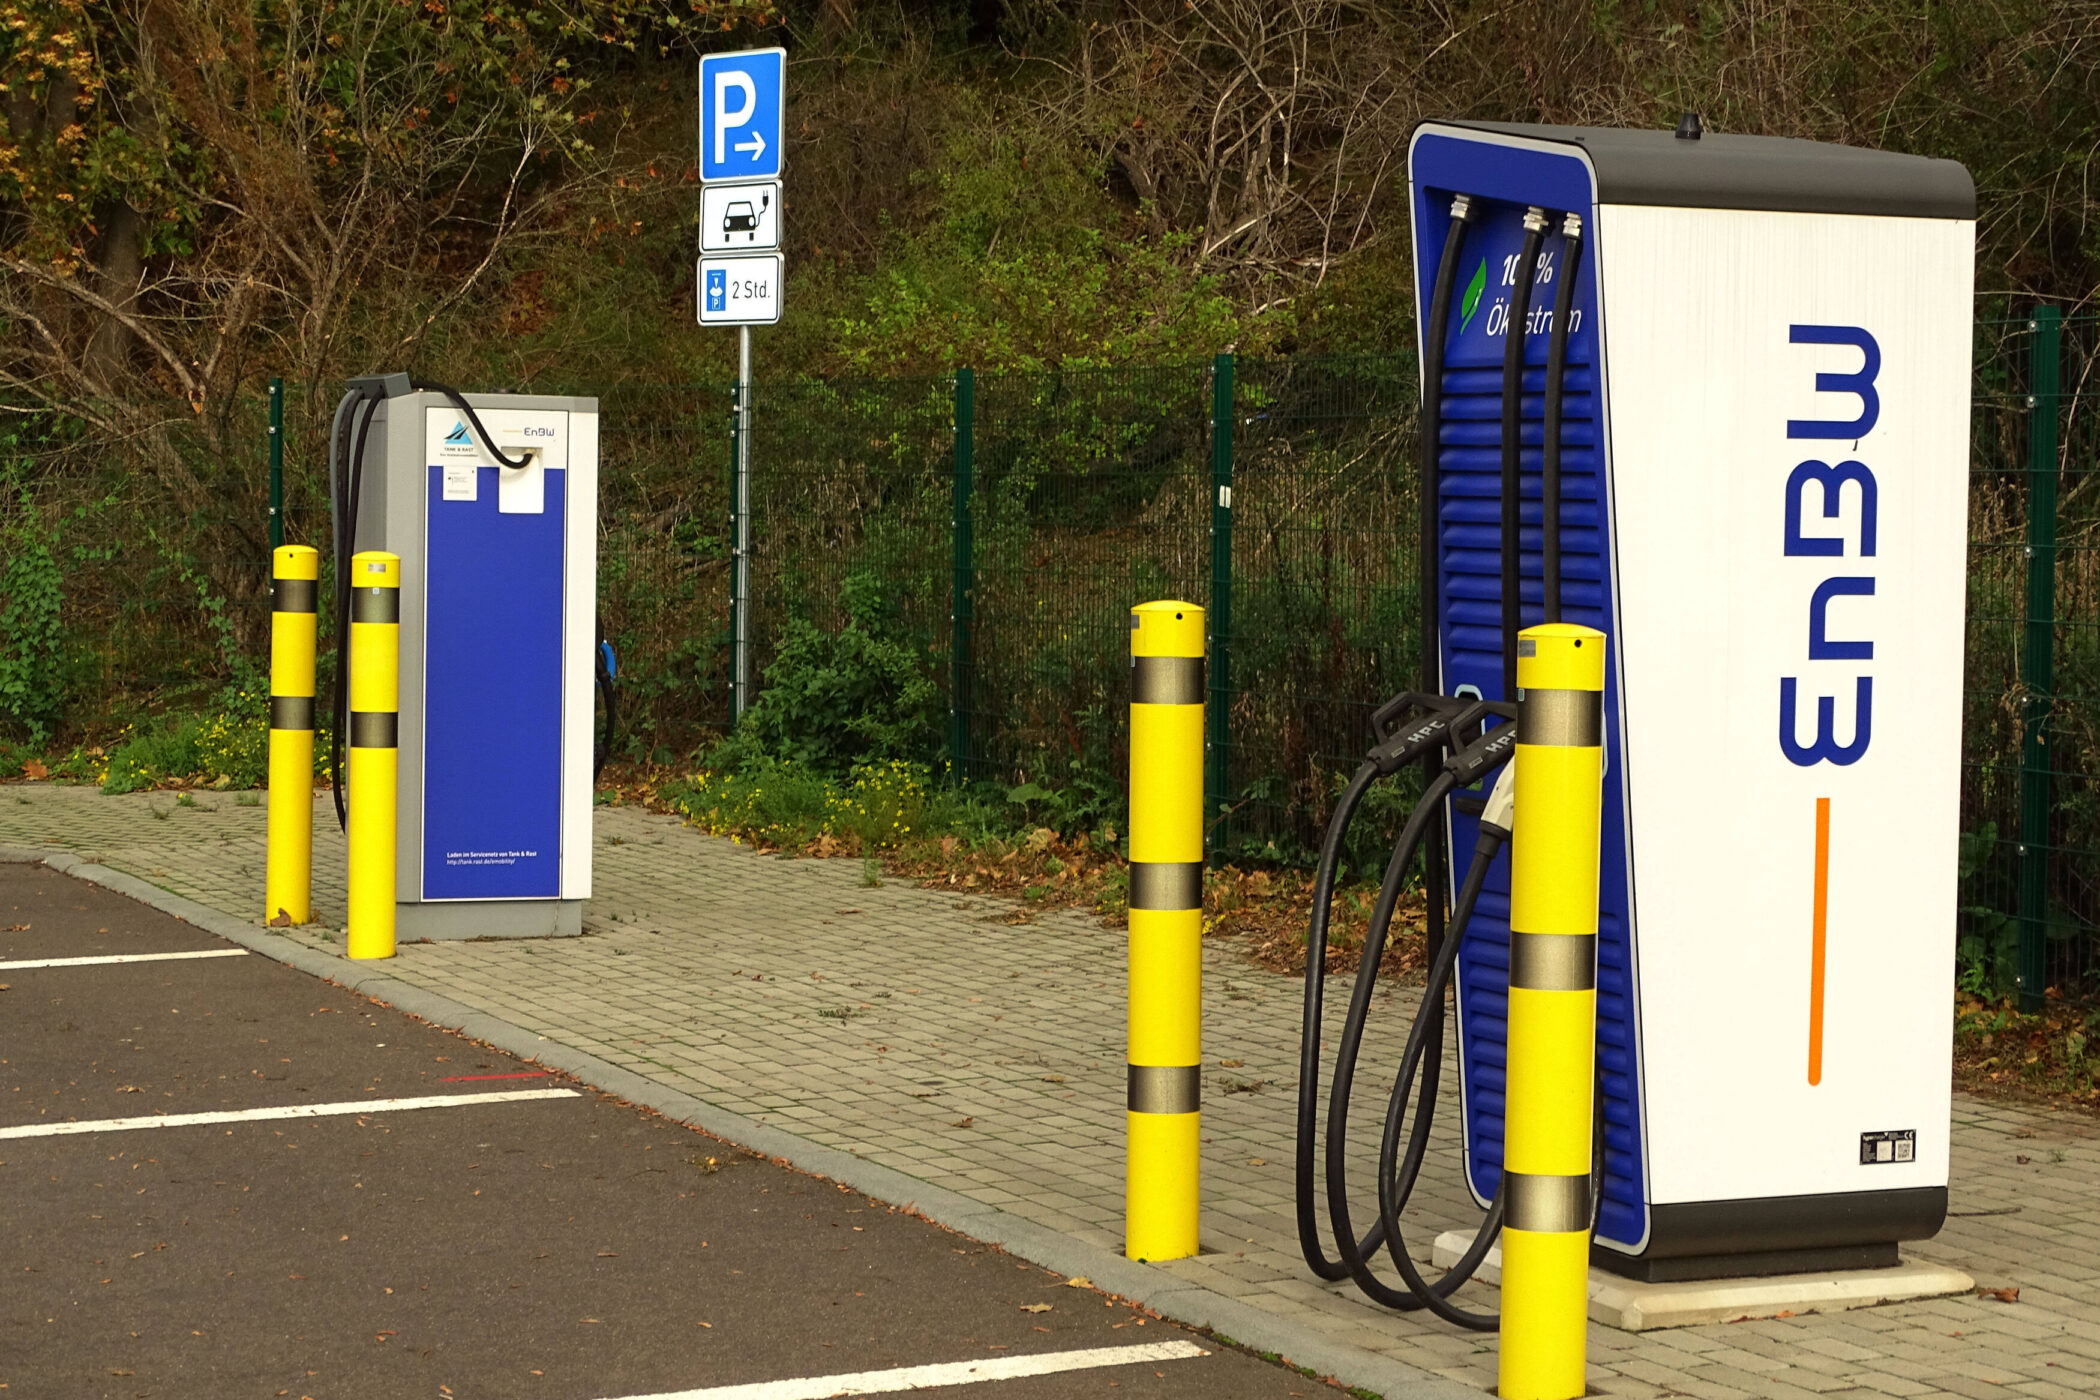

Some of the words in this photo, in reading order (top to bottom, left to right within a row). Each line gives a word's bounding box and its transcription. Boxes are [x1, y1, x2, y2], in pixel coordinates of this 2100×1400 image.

[714, 70, 757, 164] P
[732, 280, 740, 299] 2
[744, 279, 771, 299] Std.
[713, 298, 719, 309] P
[1486, 297, 1582, 336] Ökstrm
[524, 427, 555, 437] EnBW
[1778, 323, 1882, 767] EnBW
[1407, 720, 1446, 743] HPC
